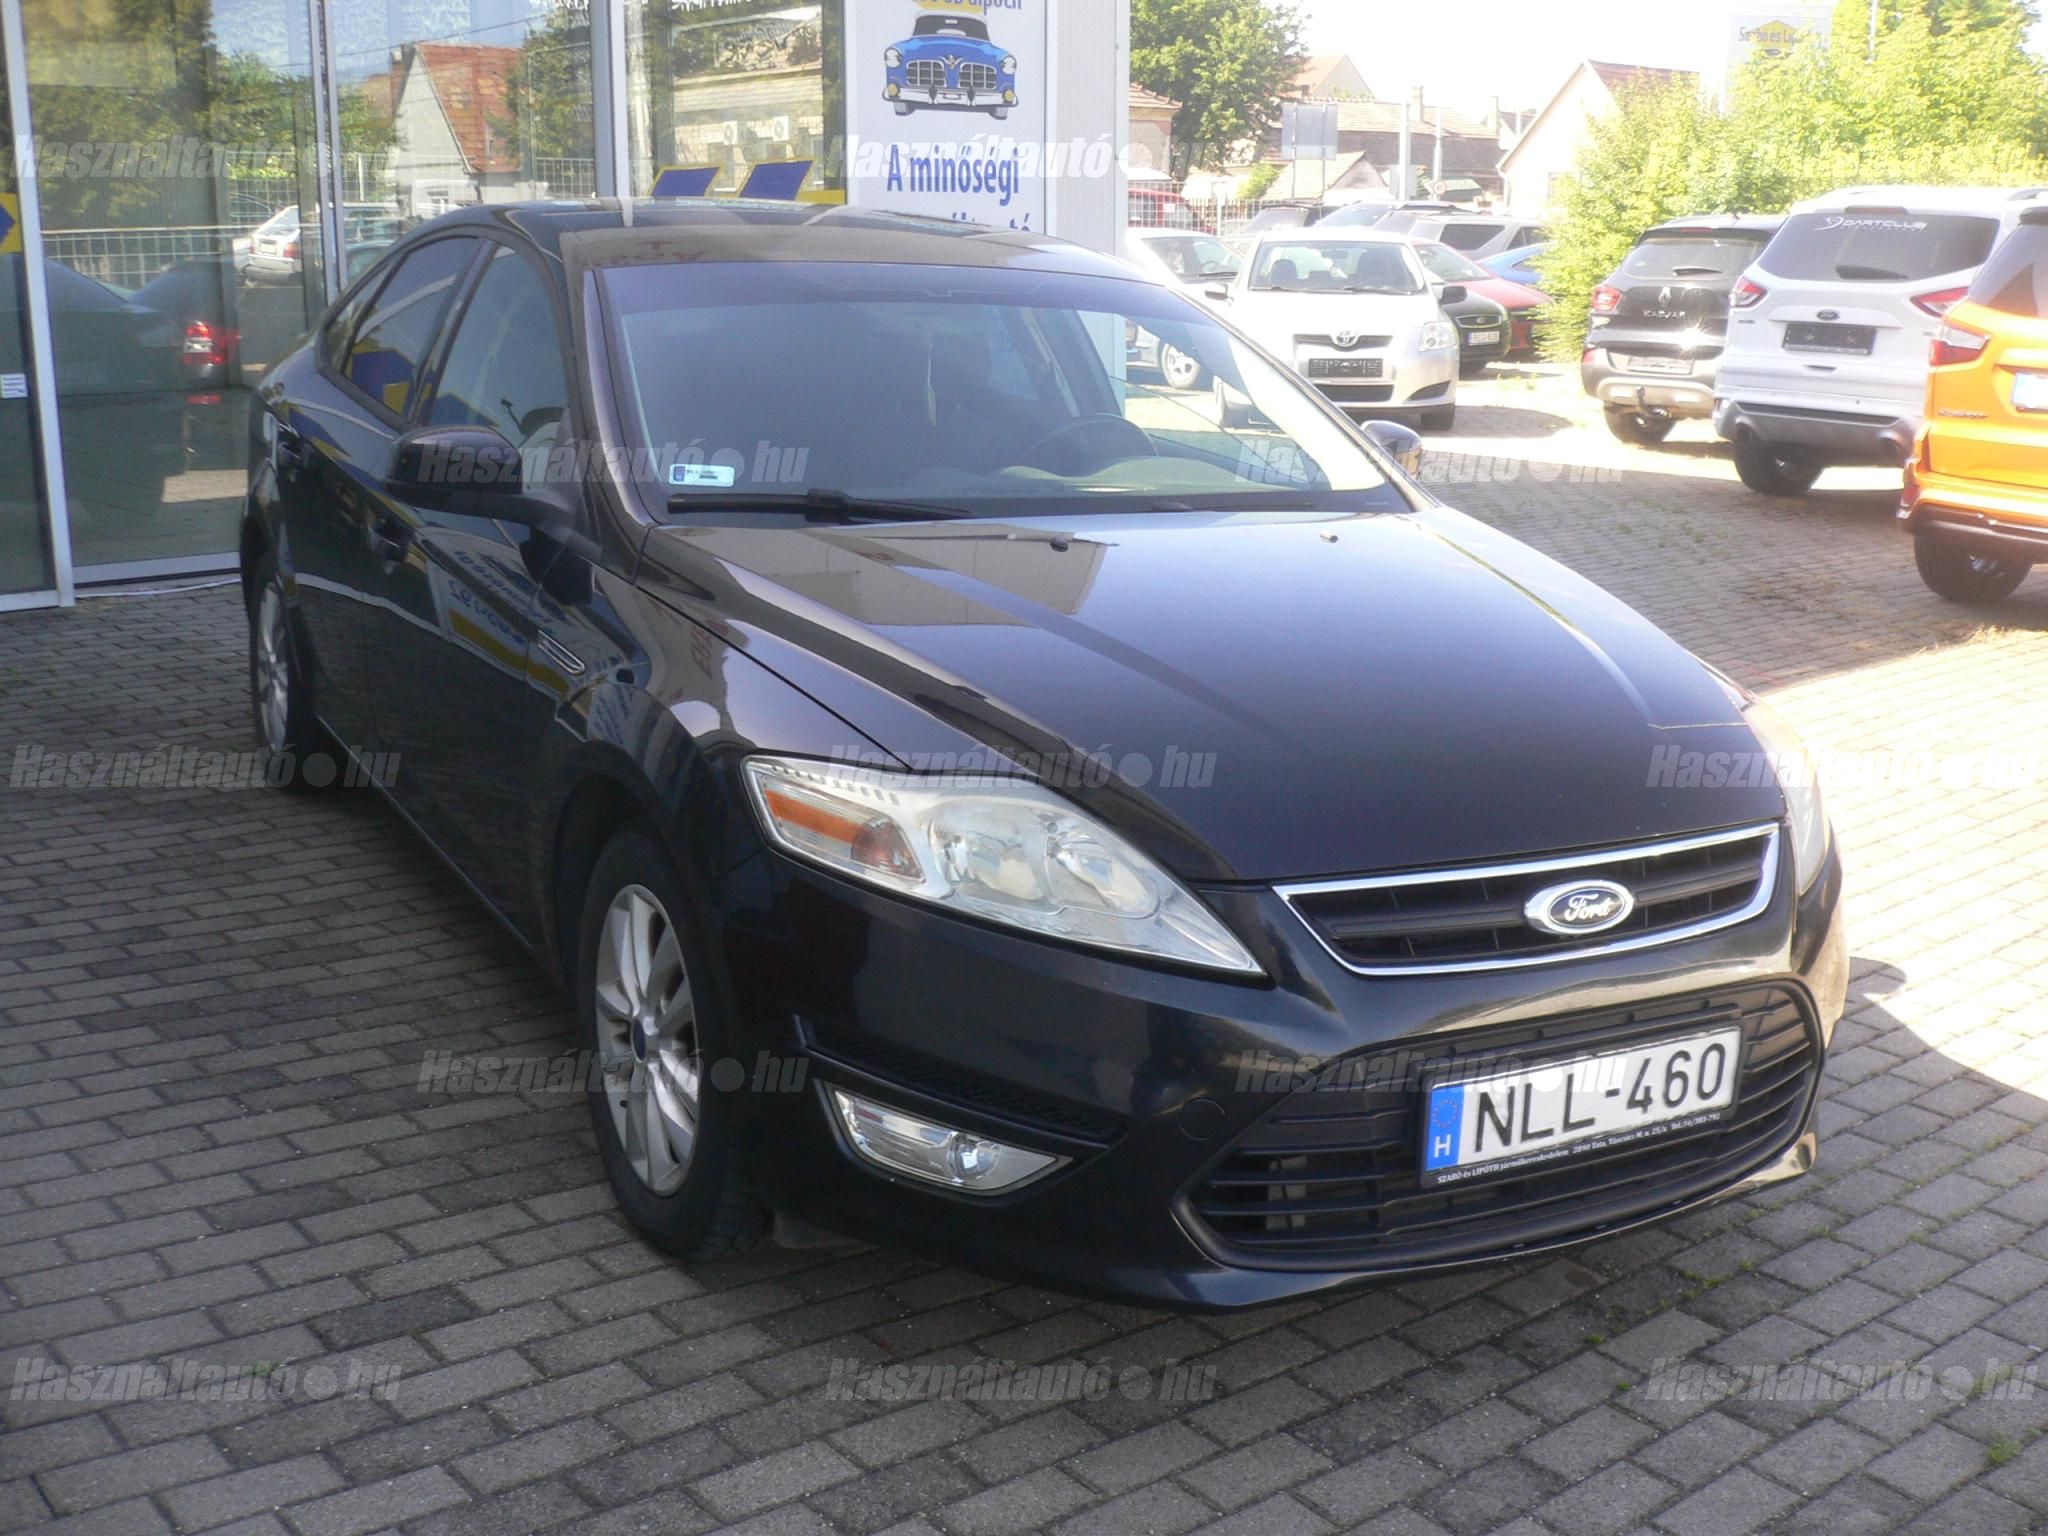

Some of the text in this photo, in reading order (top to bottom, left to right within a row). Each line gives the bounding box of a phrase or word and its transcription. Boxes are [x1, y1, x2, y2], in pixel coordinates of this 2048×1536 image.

[887, 144, 1019, 207] A minőségi
[1563, 893, 1615, 922] Ford
[1474, 1042, 1726, 1153] NLL-460
[1433, 1134, 1452, 1158] H
[1437, 1169, 1462, 1184] SZABÓ
[1472, 1163, 1500, 1176] LIPÓTH
